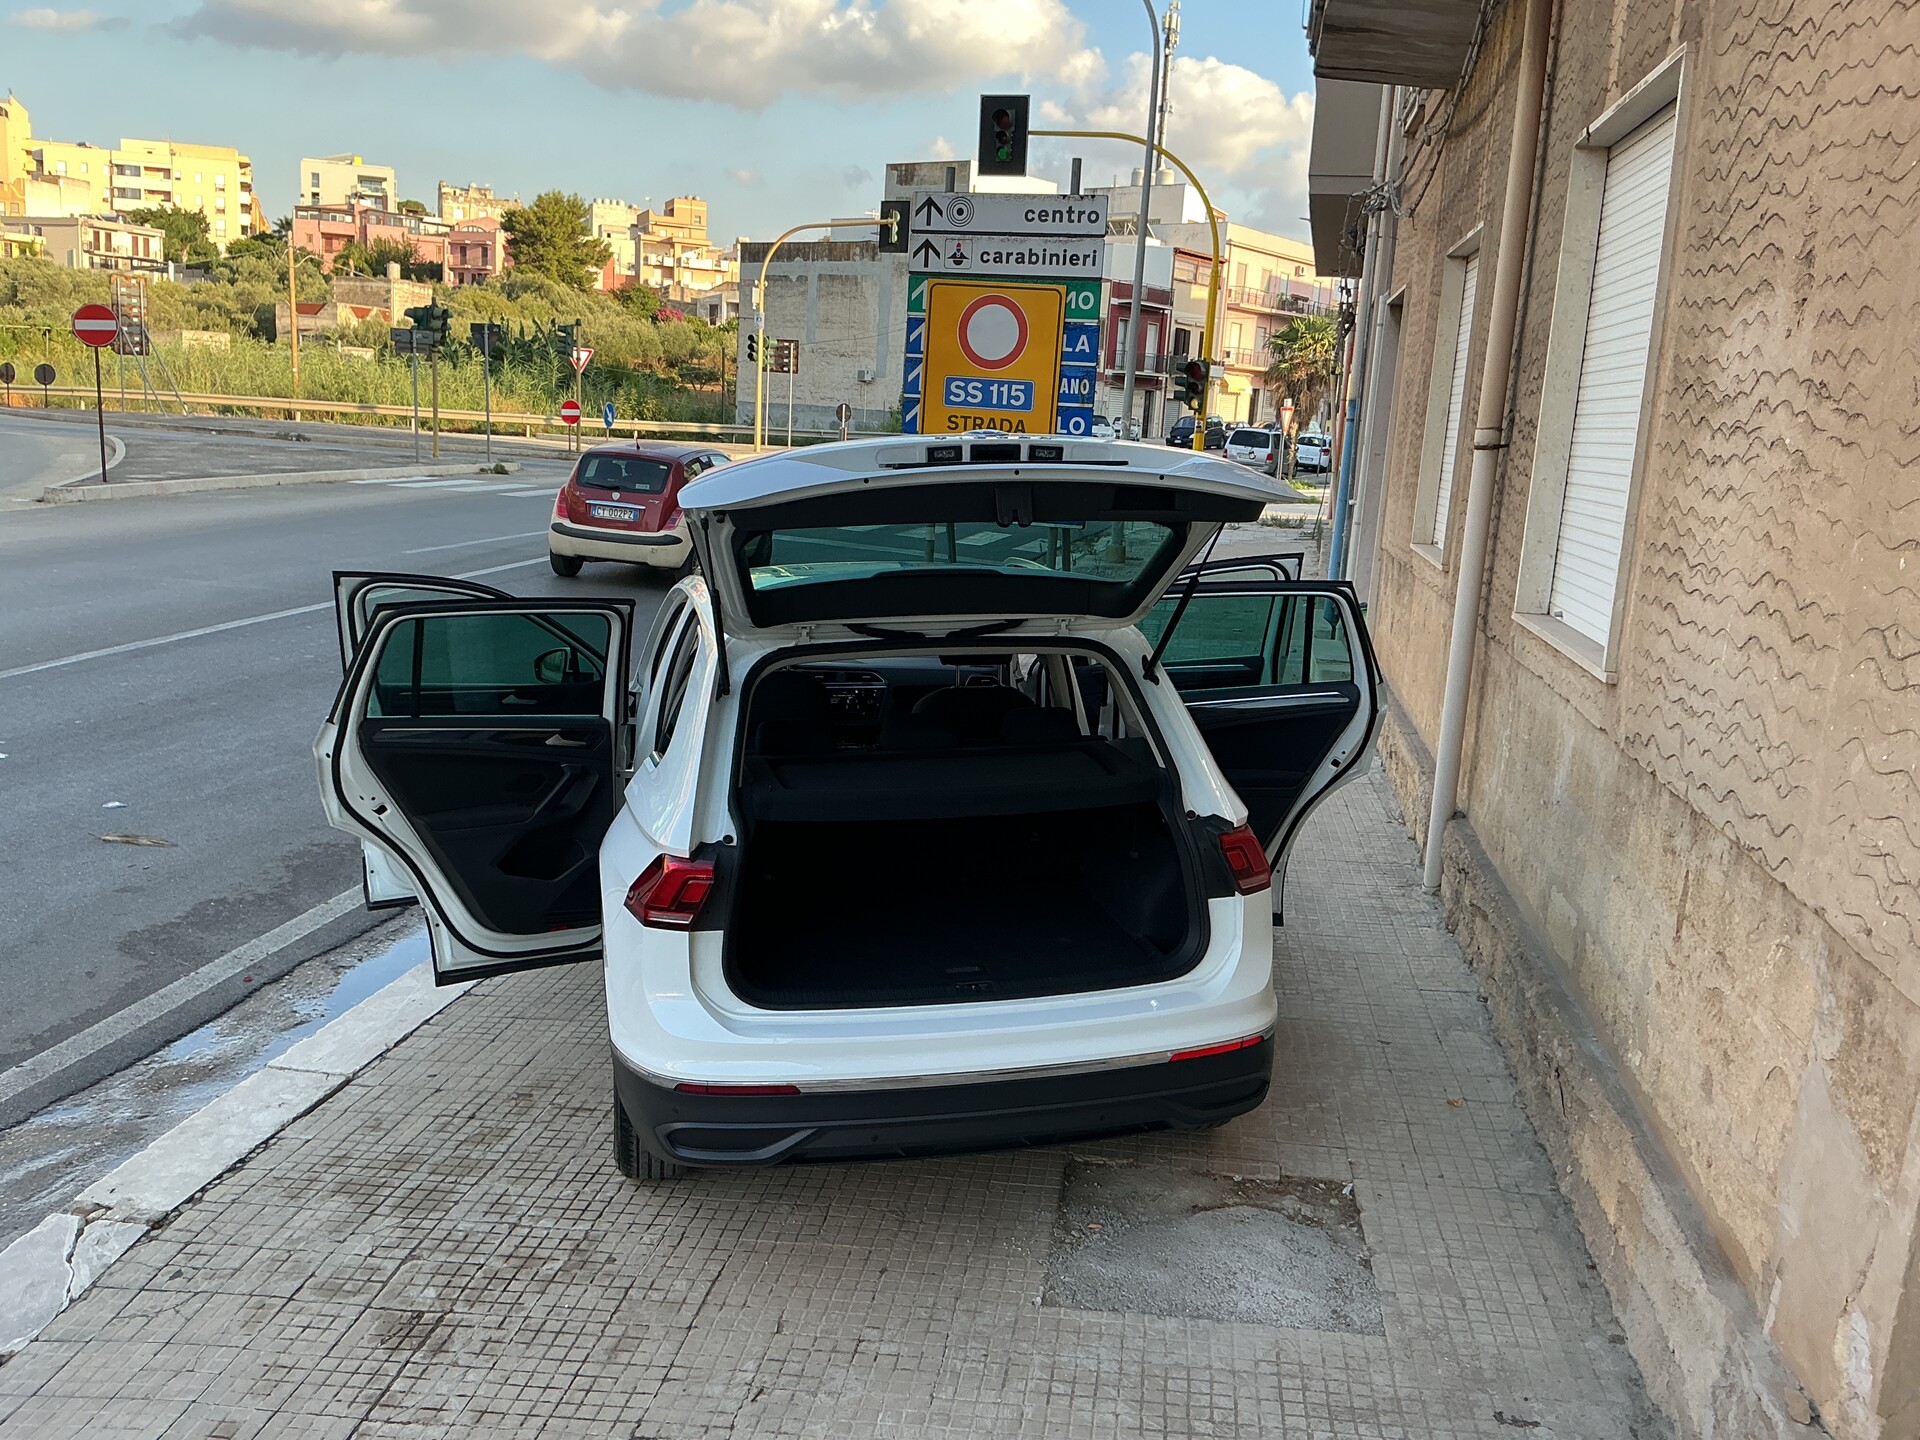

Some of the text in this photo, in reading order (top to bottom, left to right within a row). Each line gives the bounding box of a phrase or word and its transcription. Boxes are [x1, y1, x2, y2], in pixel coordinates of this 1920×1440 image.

[1024, 205, 1100, 224] centro
[979, 248, 1097, 267] carabinieri
[949, 380, 1025, 406] SS 115
[946, 414, 1026, 434] STRADA
